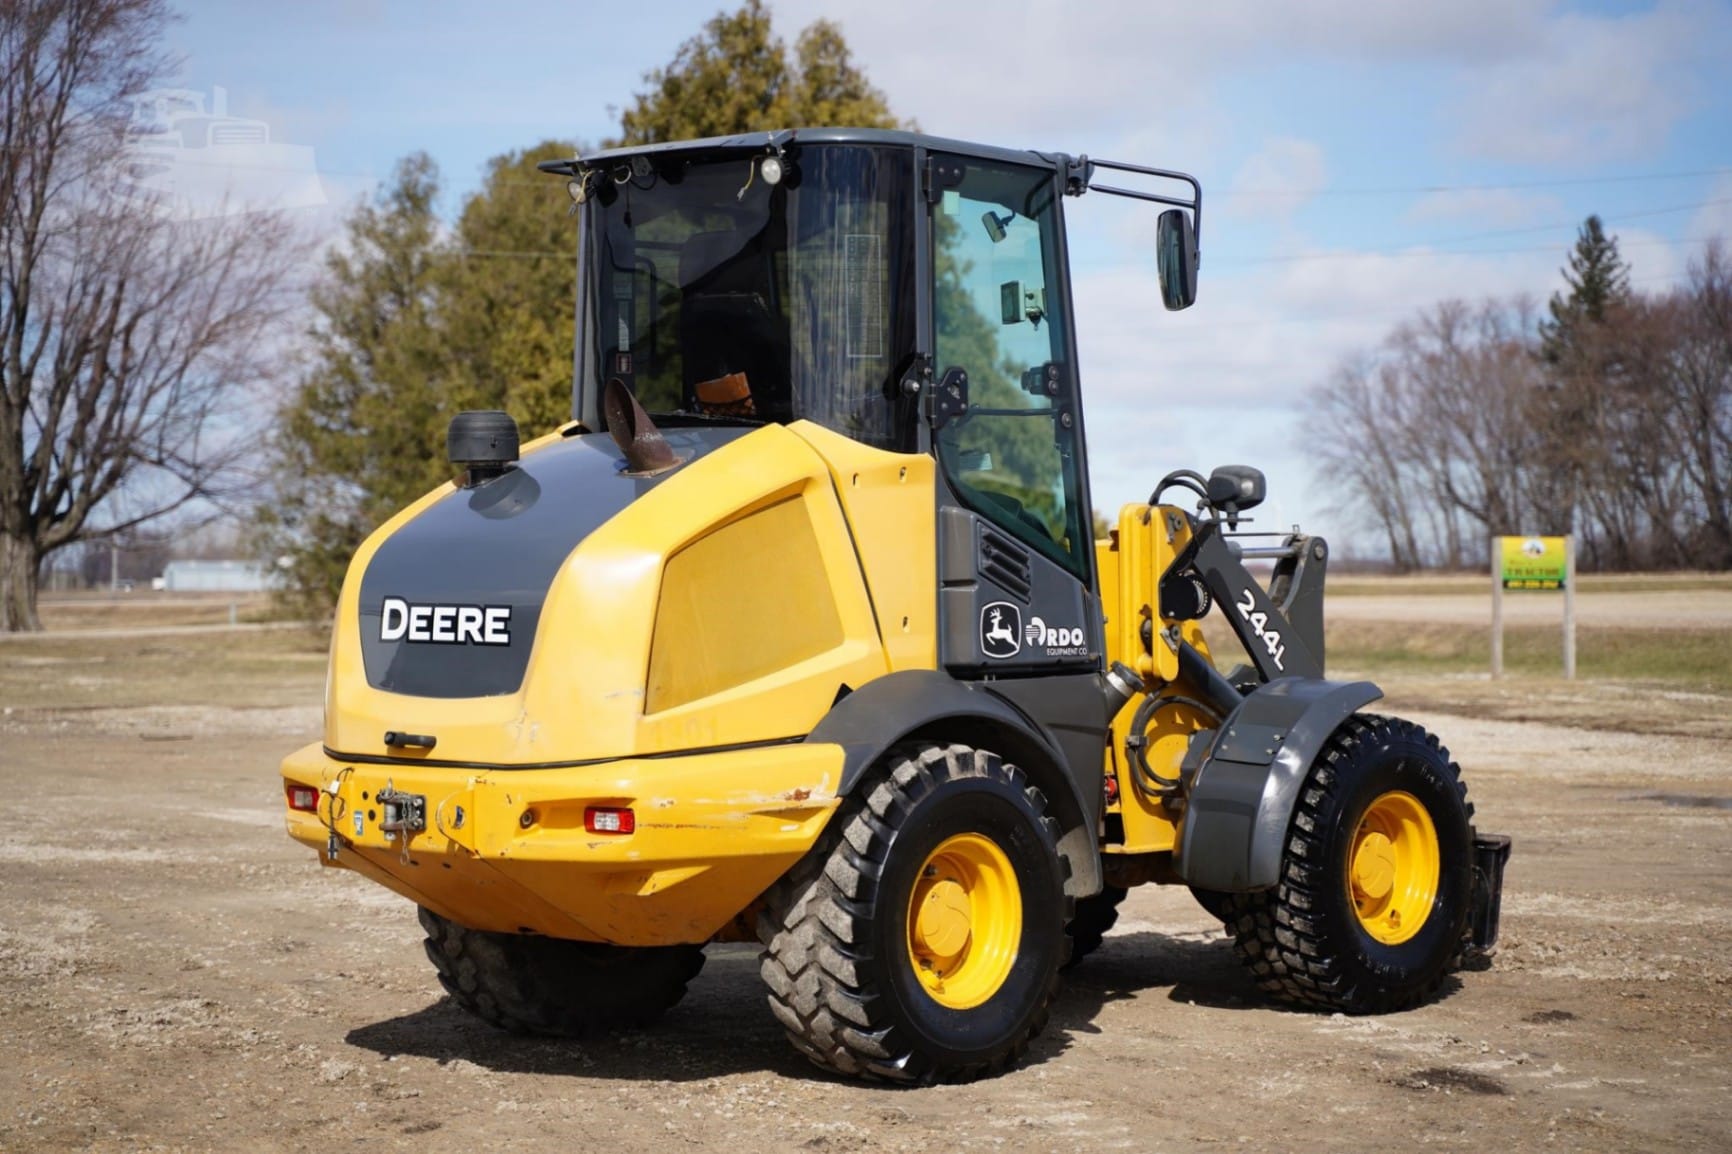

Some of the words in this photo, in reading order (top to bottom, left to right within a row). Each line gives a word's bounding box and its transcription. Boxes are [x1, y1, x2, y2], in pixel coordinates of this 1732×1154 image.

[380, 598, 511, 644] DEERE
[1236, 588, 1285, 671] 244L
[1046, 647, 1078, 656] EQUIPMENT
